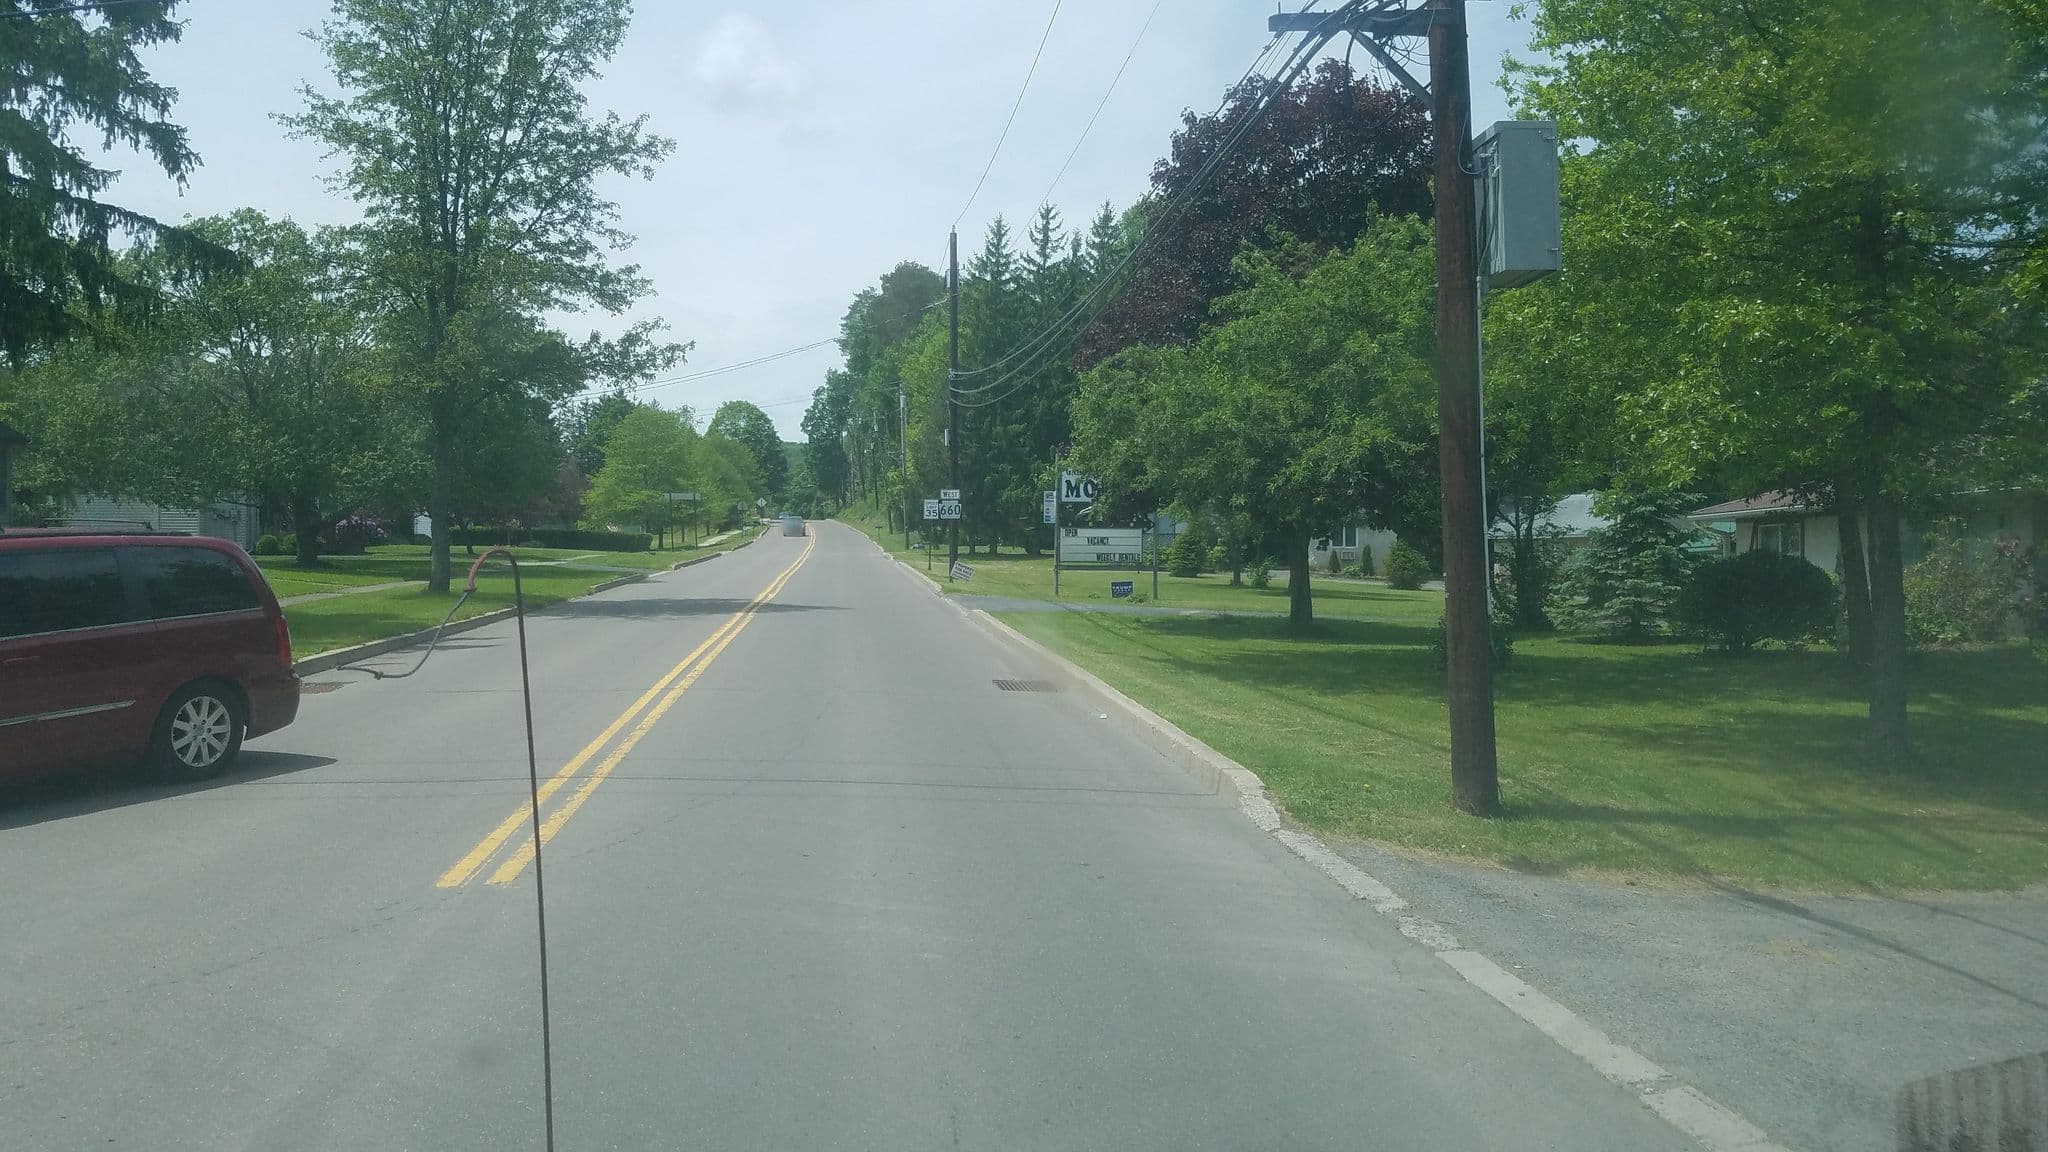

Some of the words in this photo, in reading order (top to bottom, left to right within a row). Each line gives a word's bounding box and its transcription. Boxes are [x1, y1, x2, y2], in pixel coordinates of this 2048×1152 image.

[925, 509, 938, 518] 35
[940, 504, 961, 516] 660
[1064, 528, 1078, 537] OPEN
[1086, 536, 1110, 545] VACANCY
[1096, 552, 1116, 561] WEEKLY
[1118, 552, 1141, 561] RENTALS
